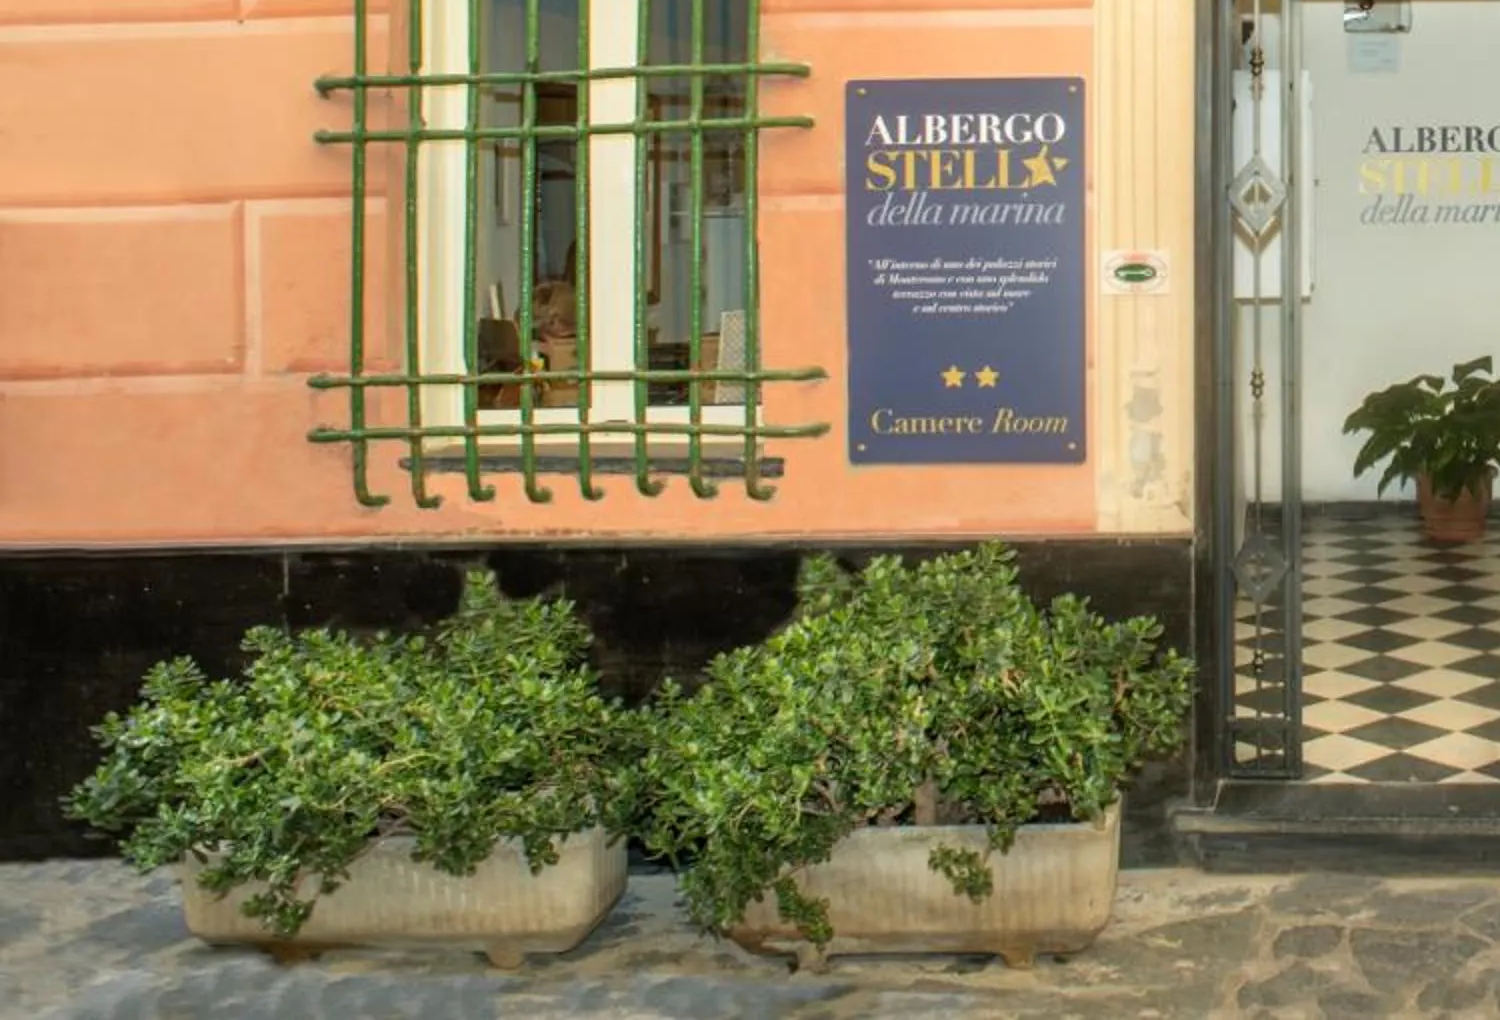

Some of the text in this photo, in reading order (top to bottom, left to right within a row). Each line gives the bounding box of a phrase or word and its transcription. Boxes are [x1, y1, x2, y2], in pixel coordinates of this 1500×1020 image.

[865, 112, 1066, 147] ALBERGO
[867, 192, 1066, 226] della marina
[1360, 193, 1430, 225] della
[873, 272, 886, 285] di
[930, 257, 942, 270] di
[964, 257, 980, 270] dei
[980, 257, 1024, 273] palazzi
[1025, 258, 1058, 270] storici
[871, 407, 1069, 435] Camere Room
